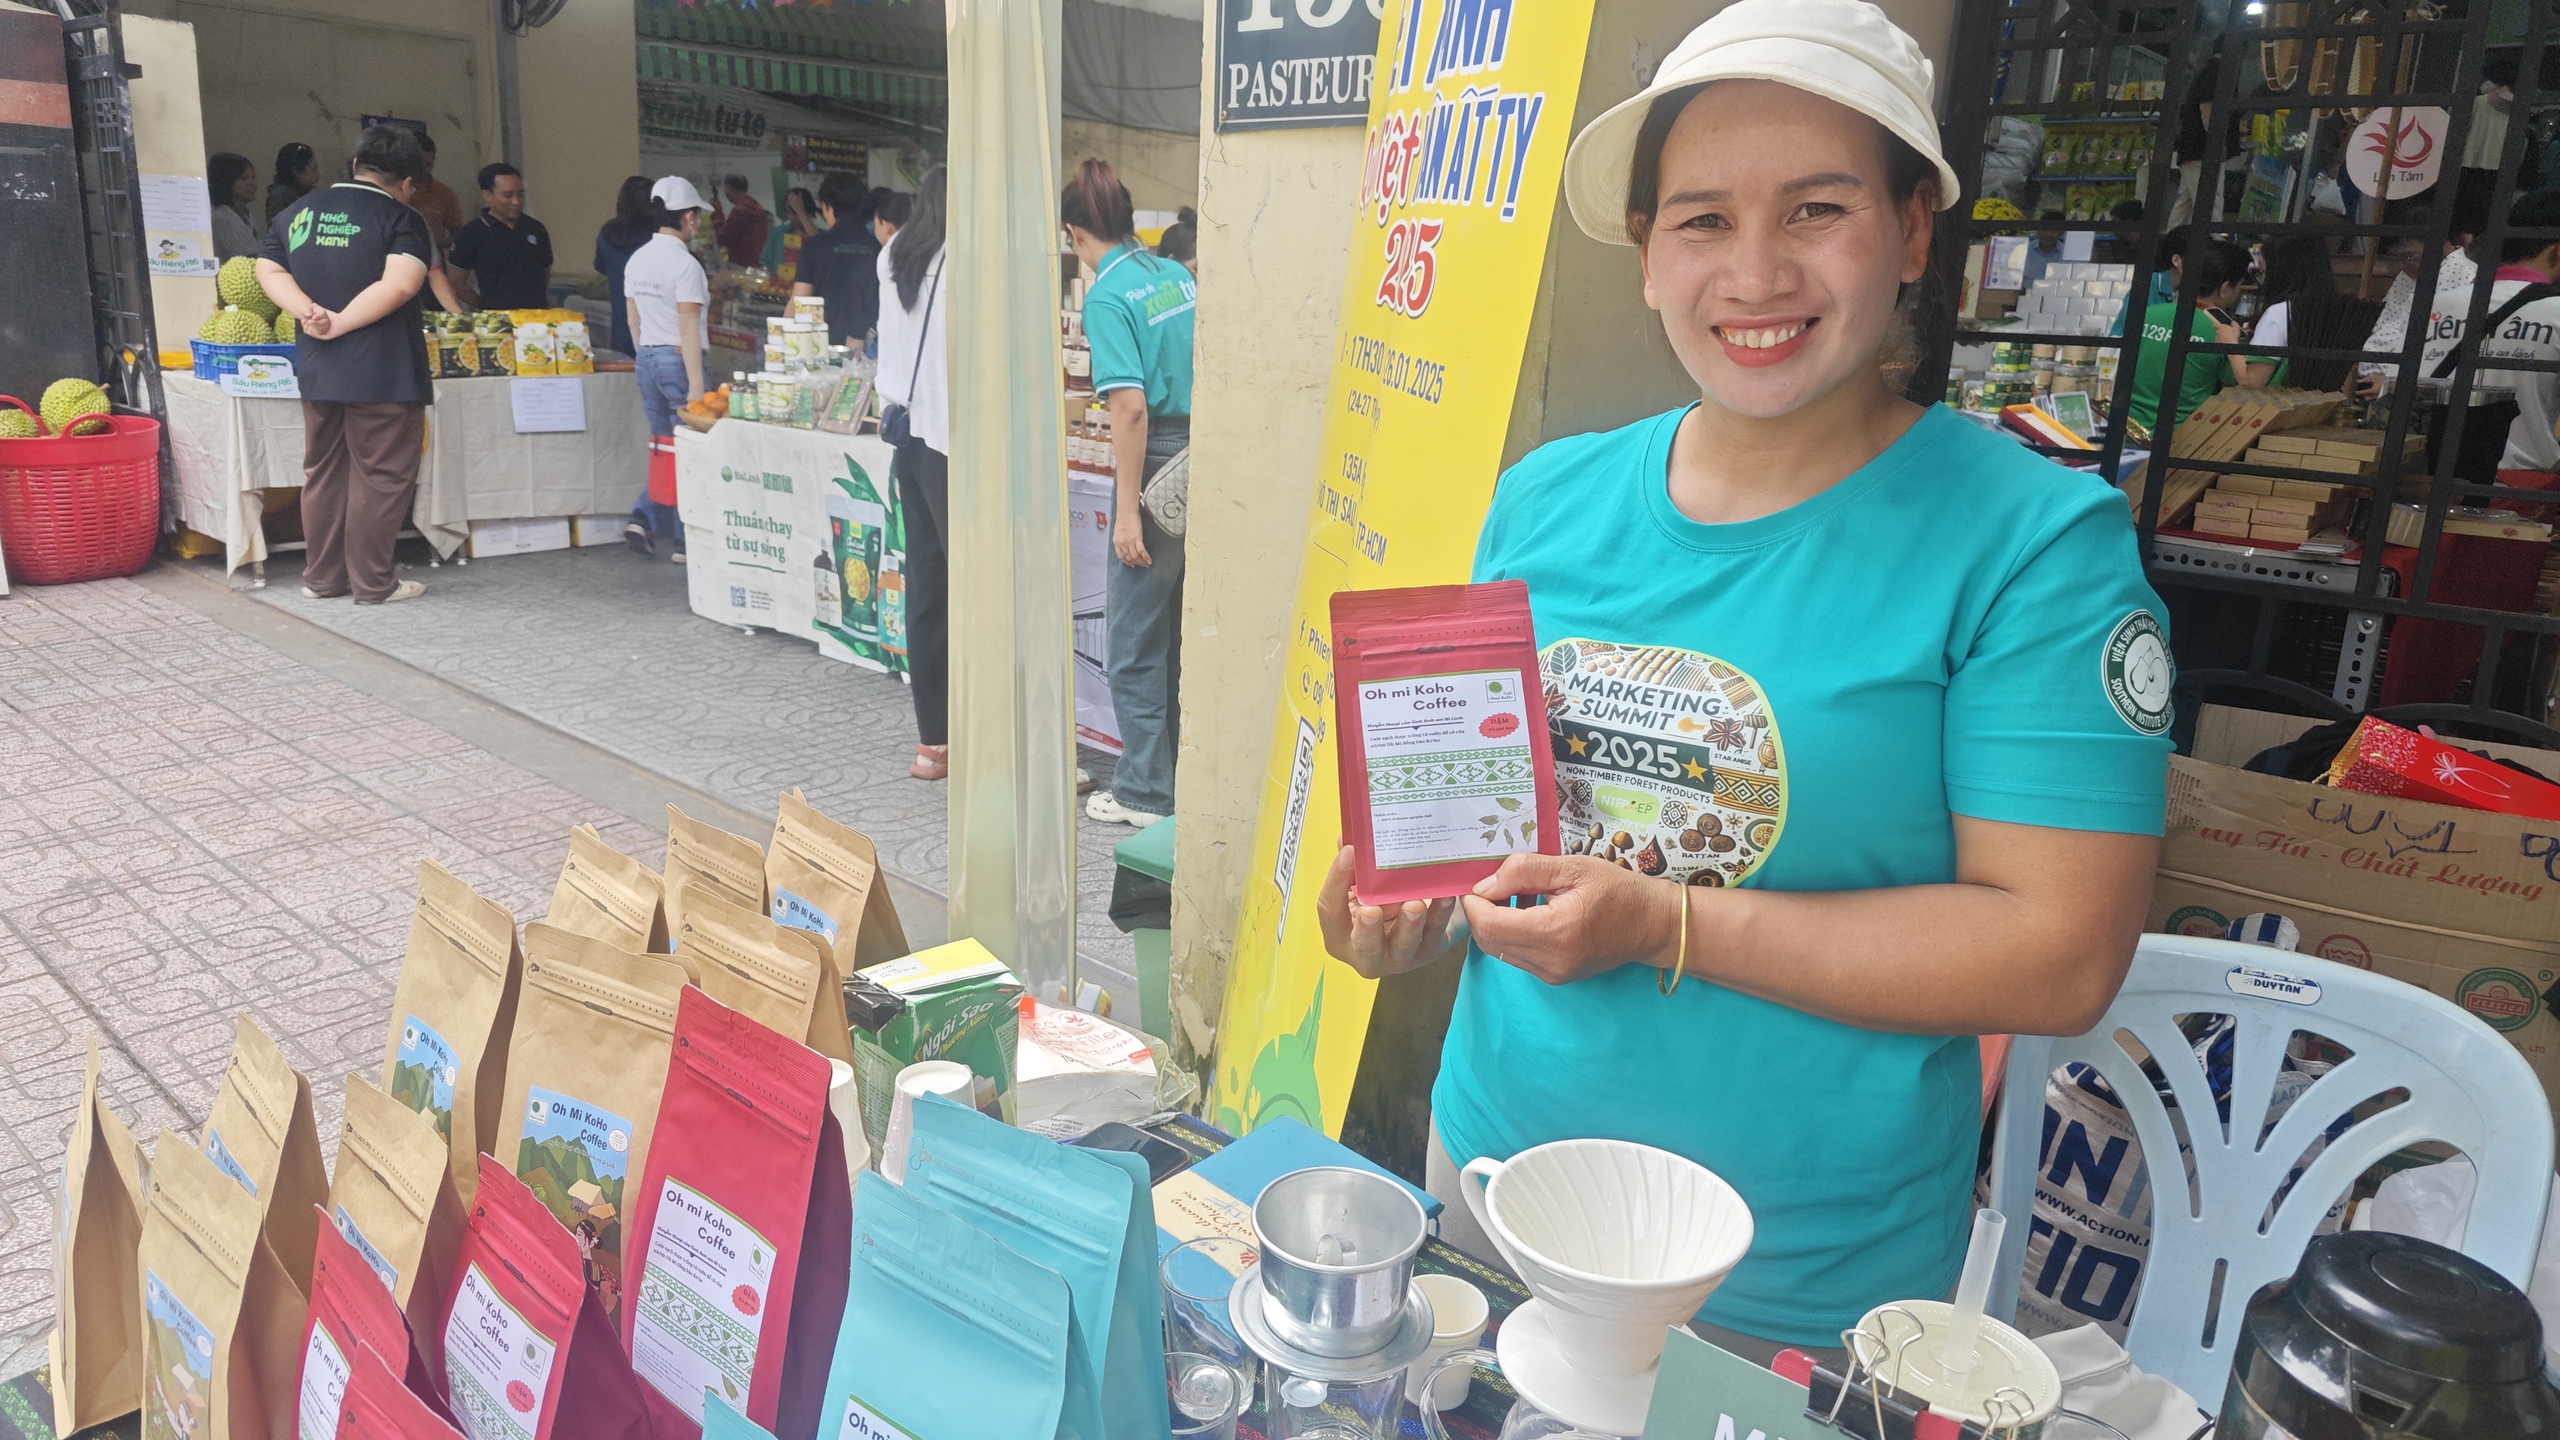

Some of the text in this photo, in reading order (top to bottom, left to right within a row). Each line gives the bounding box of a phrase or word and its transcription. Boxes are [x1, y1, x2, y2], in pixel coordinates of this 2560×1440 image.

[1227, 54, 1377, 108] PASTEUR
[2399, 170, 2424, 182] Tâm
[319, 212, 348, 224] KHỞI
[316, 235, 349, 248] XANH
[317, 223, 361, 238] NGHIỆP
[2120, 624, 2137, 645] SINH
[1365, 682, 1454, 700] Oh mi Koho
[1569, 673, 1723, 715] MARKETING
[2111, 677, 2136, 717] SOUTHERN
[1413, 697, 1467, 711] Coffee
[1579, 698, 1675, 731] SUMMIT
[1587, 731, 1681, 778] 2025
[1714, 753, 1752, 766] STAR ANISE
[1566, 766, 1711, 804] NON-TIMBER FOREST PRODUCTS
[2256, 830, 2310, 859] Tín
[2340, 847, 2422, 879] Chất
[2428, 863, 2544, 902] Lượng
[790, 901, 799, 913] Oh
[800, 906, 808, 918] Mi
[2254, 978, 2301, 994] DUYTAN
[2472, 999, 2523, 1013] JESSICA
[420, 1032, 430, 1046] Oh
[922, 1002, 994, 1061] Ngôi Sao
[552, 1102, 608, 1131] Oh Mi KoHo
[580, 1129, 608, 1150] Coffee
[666, 1190, 732, 1237] Oh mi Koho
[348, 1225, 356, 1239] Oh
[698, 1227, 736, 1260] Coffee
[465, 1275, 508, 1329] Oh mi Koho
[480, 1316, 510, 1353] Coffee
[312, 1335, 323, 1355] Oh
[324, 1353, 334, 1370] mi
[849, 1412, 868, 1435] Oh
